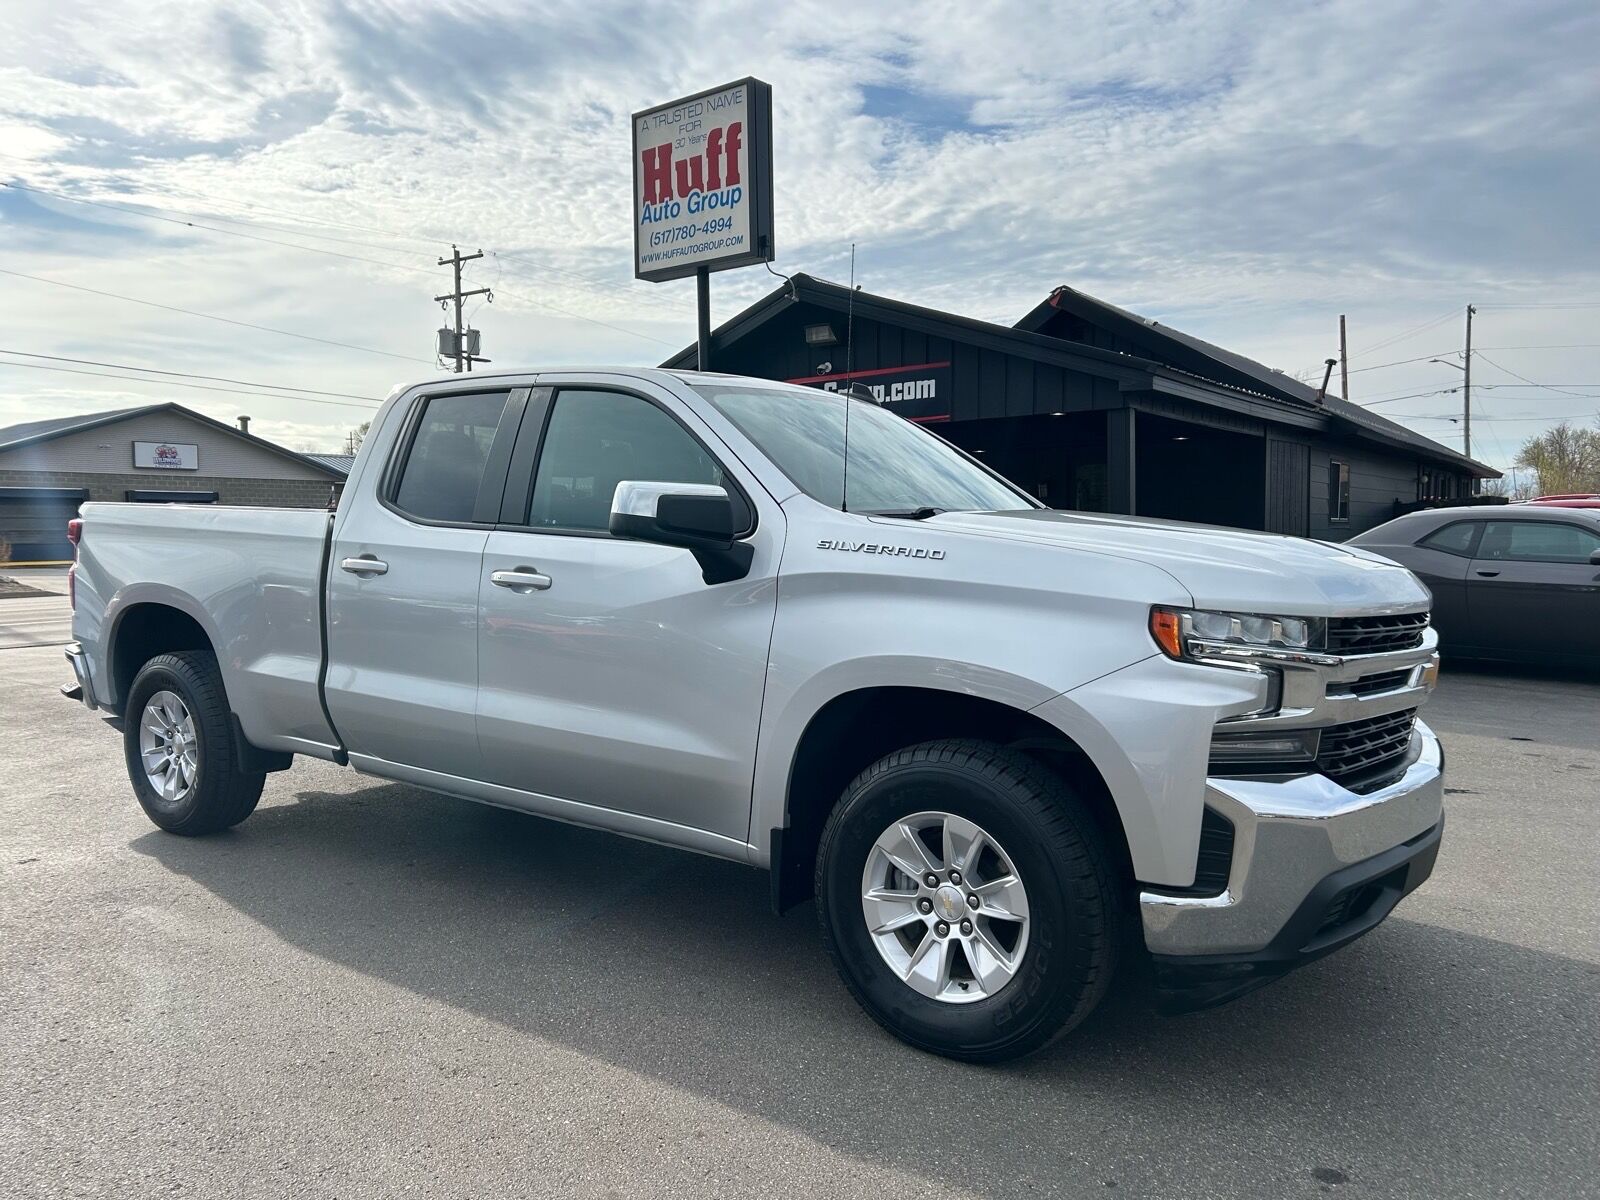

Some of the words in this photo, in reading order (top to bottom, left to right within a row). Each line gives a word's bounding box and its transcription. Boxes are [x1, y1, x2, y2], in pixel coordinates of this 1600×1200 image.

[642, 120, 649, 132] A
[652, 103, 703, 127] TRUSTED
[707, 90, 742, 112] NAME
[675, 138, 686, 149] 30
[688, 133, 708, 145] Years
[678, 120, 702, 134] FOR
[641, 122, 742, 208] Huff
[641, 201, 681, 225] Auto
[687, 187, 742, 214] Group
[650, 216, 733, 247] (517)780-4994
[641, 235, 743, 263] WWW.HUFFAUTOGROUP.COM
[816, 539, 947, 560] SILVERADO
